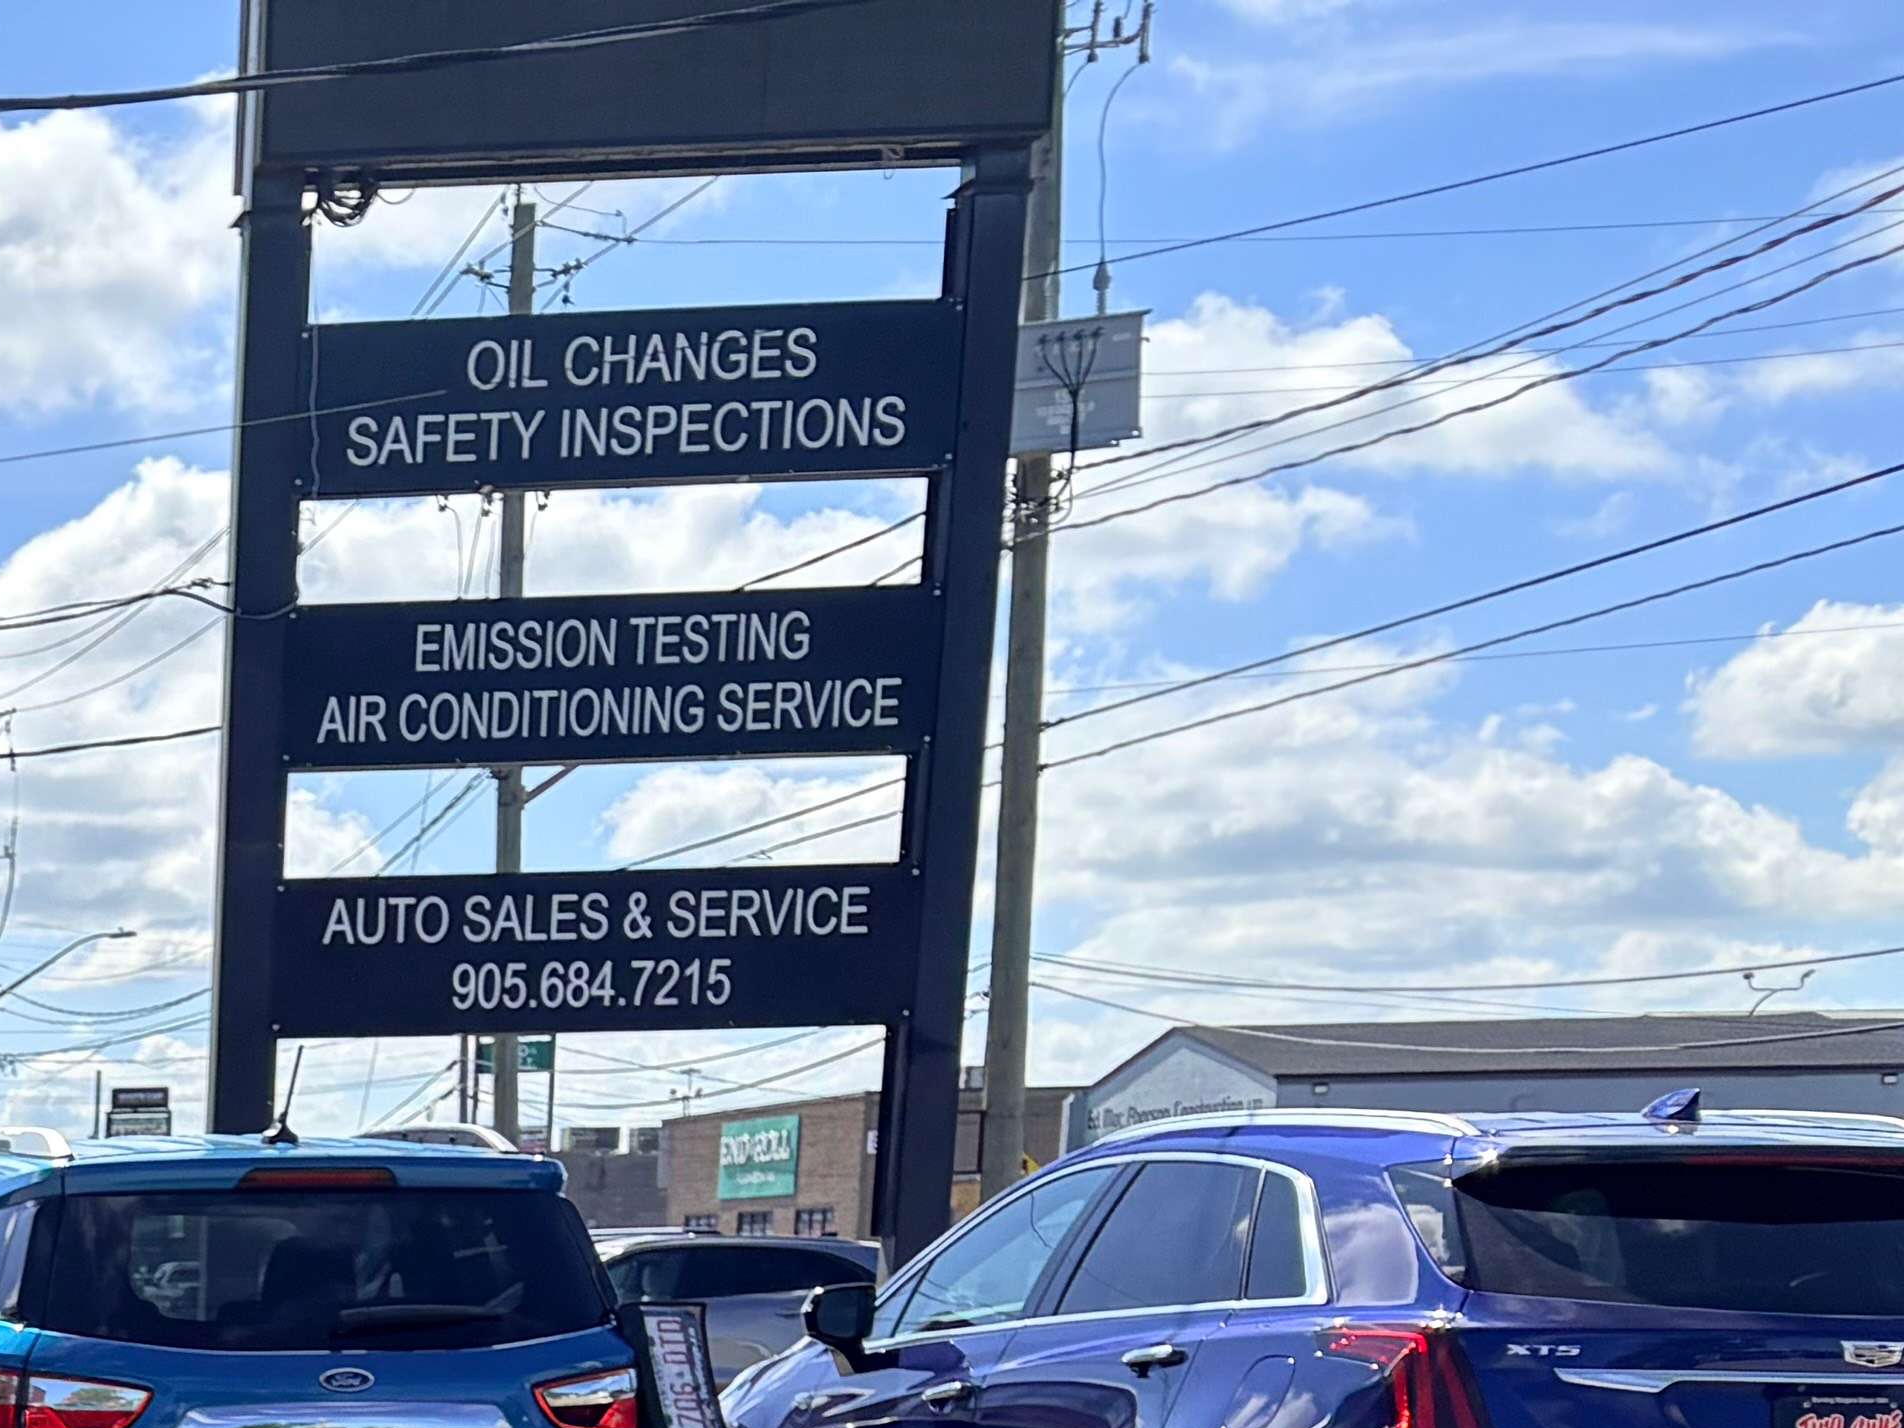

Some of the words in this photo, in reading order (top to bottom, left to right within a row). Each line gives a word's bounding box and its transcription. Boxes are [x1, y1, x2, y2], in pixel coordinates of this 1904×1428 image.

[466, 339, 548, 390] OIL
[563, 326, 818, 388] CHANGES
[346, 408, 546, 466] SAFETY
[559, 395, 907, 459] INSPECTIONS
[414, 617, 617, 672] EMISSION
[629, 610, 811, 665] TESTING
[316, 695, 388, 743] AIR
[398, 684, 705, 742] CONDITIONING
[716, 677, 903, 733] SERVICE
[322, 896, 450, 945] AUTO
[462, 891, 610, 943] SALES
[622, 890, 653, 939] &
[666, 886, 871, 938] SERVICE
[451, 957, 733, 1010] 905.684.7215
